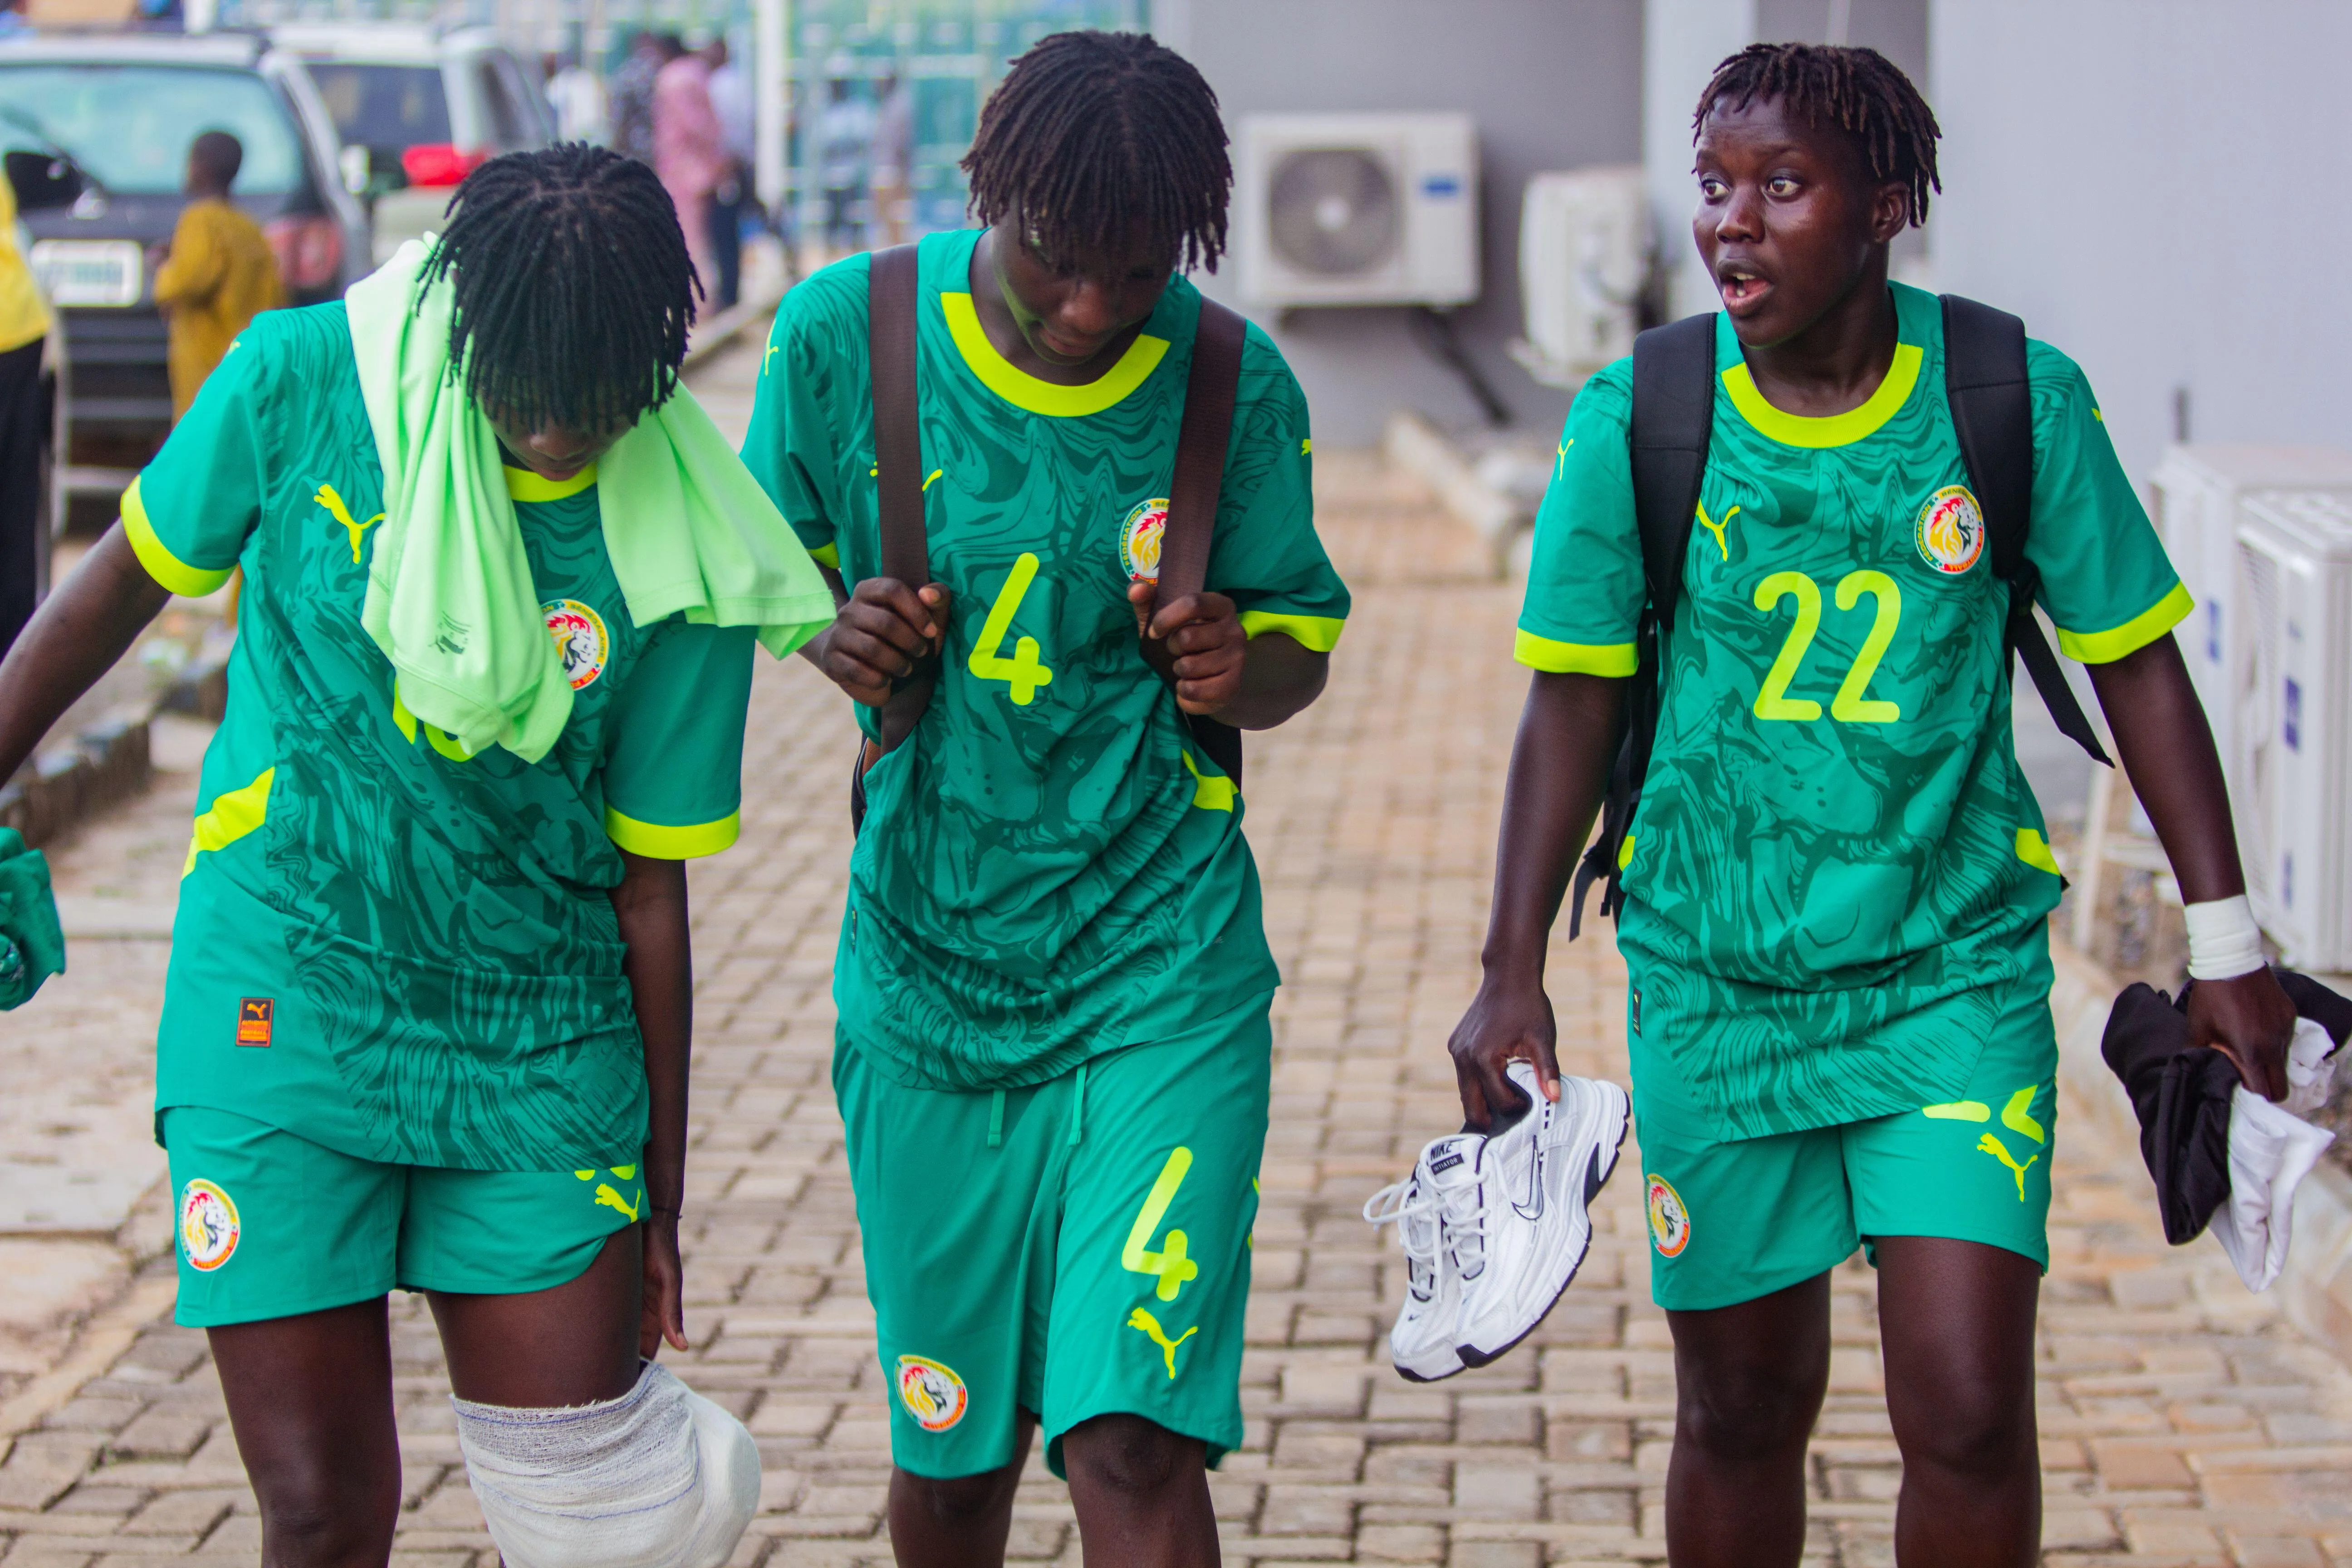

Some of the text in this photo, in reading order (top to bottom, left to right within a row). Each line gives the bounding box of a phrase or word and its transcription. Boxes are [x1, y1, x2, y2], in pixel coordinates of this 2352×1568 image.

[968, 552, 1053, 706] 4
[1754, 569, 1901, 723] 22
[1122, 1147, 1198, 1301] 4
